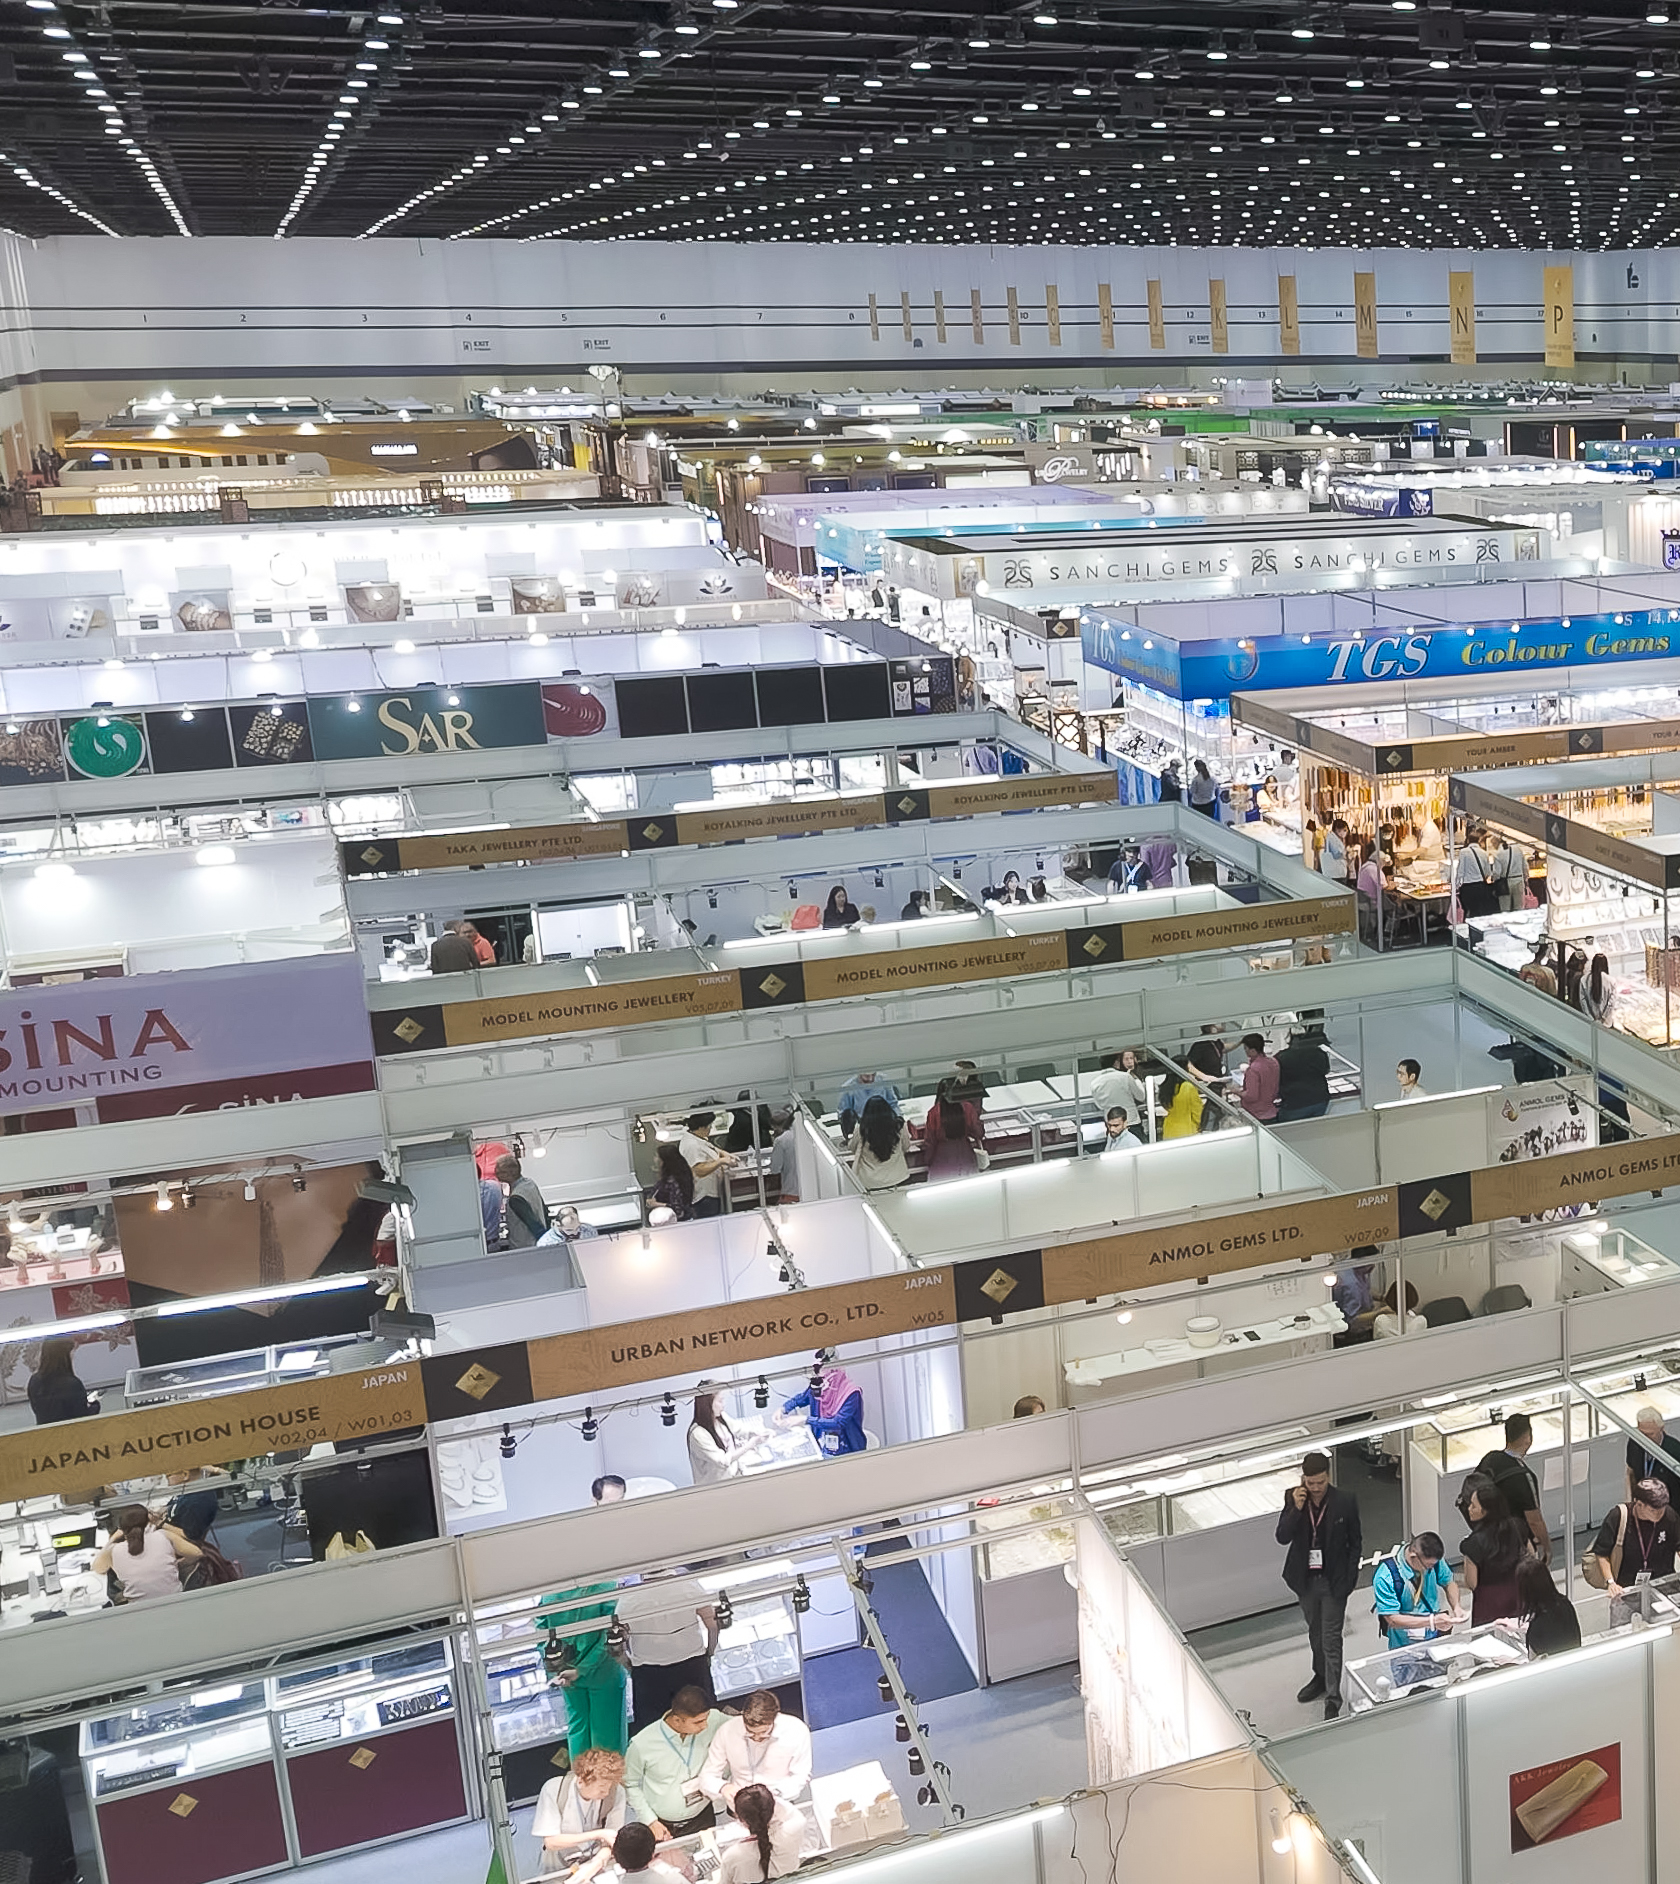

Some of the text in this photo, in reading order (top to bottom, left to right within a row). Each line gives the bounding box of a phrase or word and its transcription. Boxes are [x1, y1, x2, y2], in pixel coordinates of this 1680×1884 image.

[1215, 308, 1223, 329] K
[1285, 307, 1292, 329] L
[1360, 306, 1372, 330] M
[1456, 307, 1468, 334] N
[1554, 305, 1564, 334] P
[1050, 558, 1229, 580] SANCHI GEMS
[1295, 548, 1456, 569] SANCHI GEMS
[1326, 634, 1432, 681] TGS
[1461, 639, 1573, 667] Colour
[1585, 631, 1671, 658] Gems
[378, 697, 485, 756] SAR
[1011, 788, 1058, 800] JEWELLERY
[766, 812, 818, 826] JEWELLERY
[821, 809, 837, 820] PTE
[446, 844, 478, 856] TAKA
[480, 839, 538, 853] JEWELLERY
[541, 837, 561, 849] PTE
[1151, 913, 1320, 945] MODEL MOUNTING JEWELLERY
[1028, 936, 1060, 947] TURKEY
[836, 951, 1026, 984] MODEL MOUNTING JEWELLERY
[696, 974, 733, 988] TURKEY
[481, 992, 695, 1028] MODEL MOUNTING JEWELLERY
[1559, 1166, 1613, 1188] ANMOL
[1619, 1157, 1659, 1175] GEMS
[1356, 1193, 1389, 1210] JAPAN
[1149, 1225, 1304, 1265] ANMOL GEMS LTD.
[1344, 1226, 1390, 1245] W07,09
[904, 1273, 942, 1291] JAPAN
[911, 1309, 945, 1326] W05
[610, 1302, 885, 1364] URBAN NETWORK CO., LTD.
[361, 1371, 408, 1390] JAPAN
[27, 1406, 321, 1474] JAPAN AUCTION HOUSE
[267, 1427, 328, 1448] V02,04
[348, 1410, 413, 1432] W01,03
